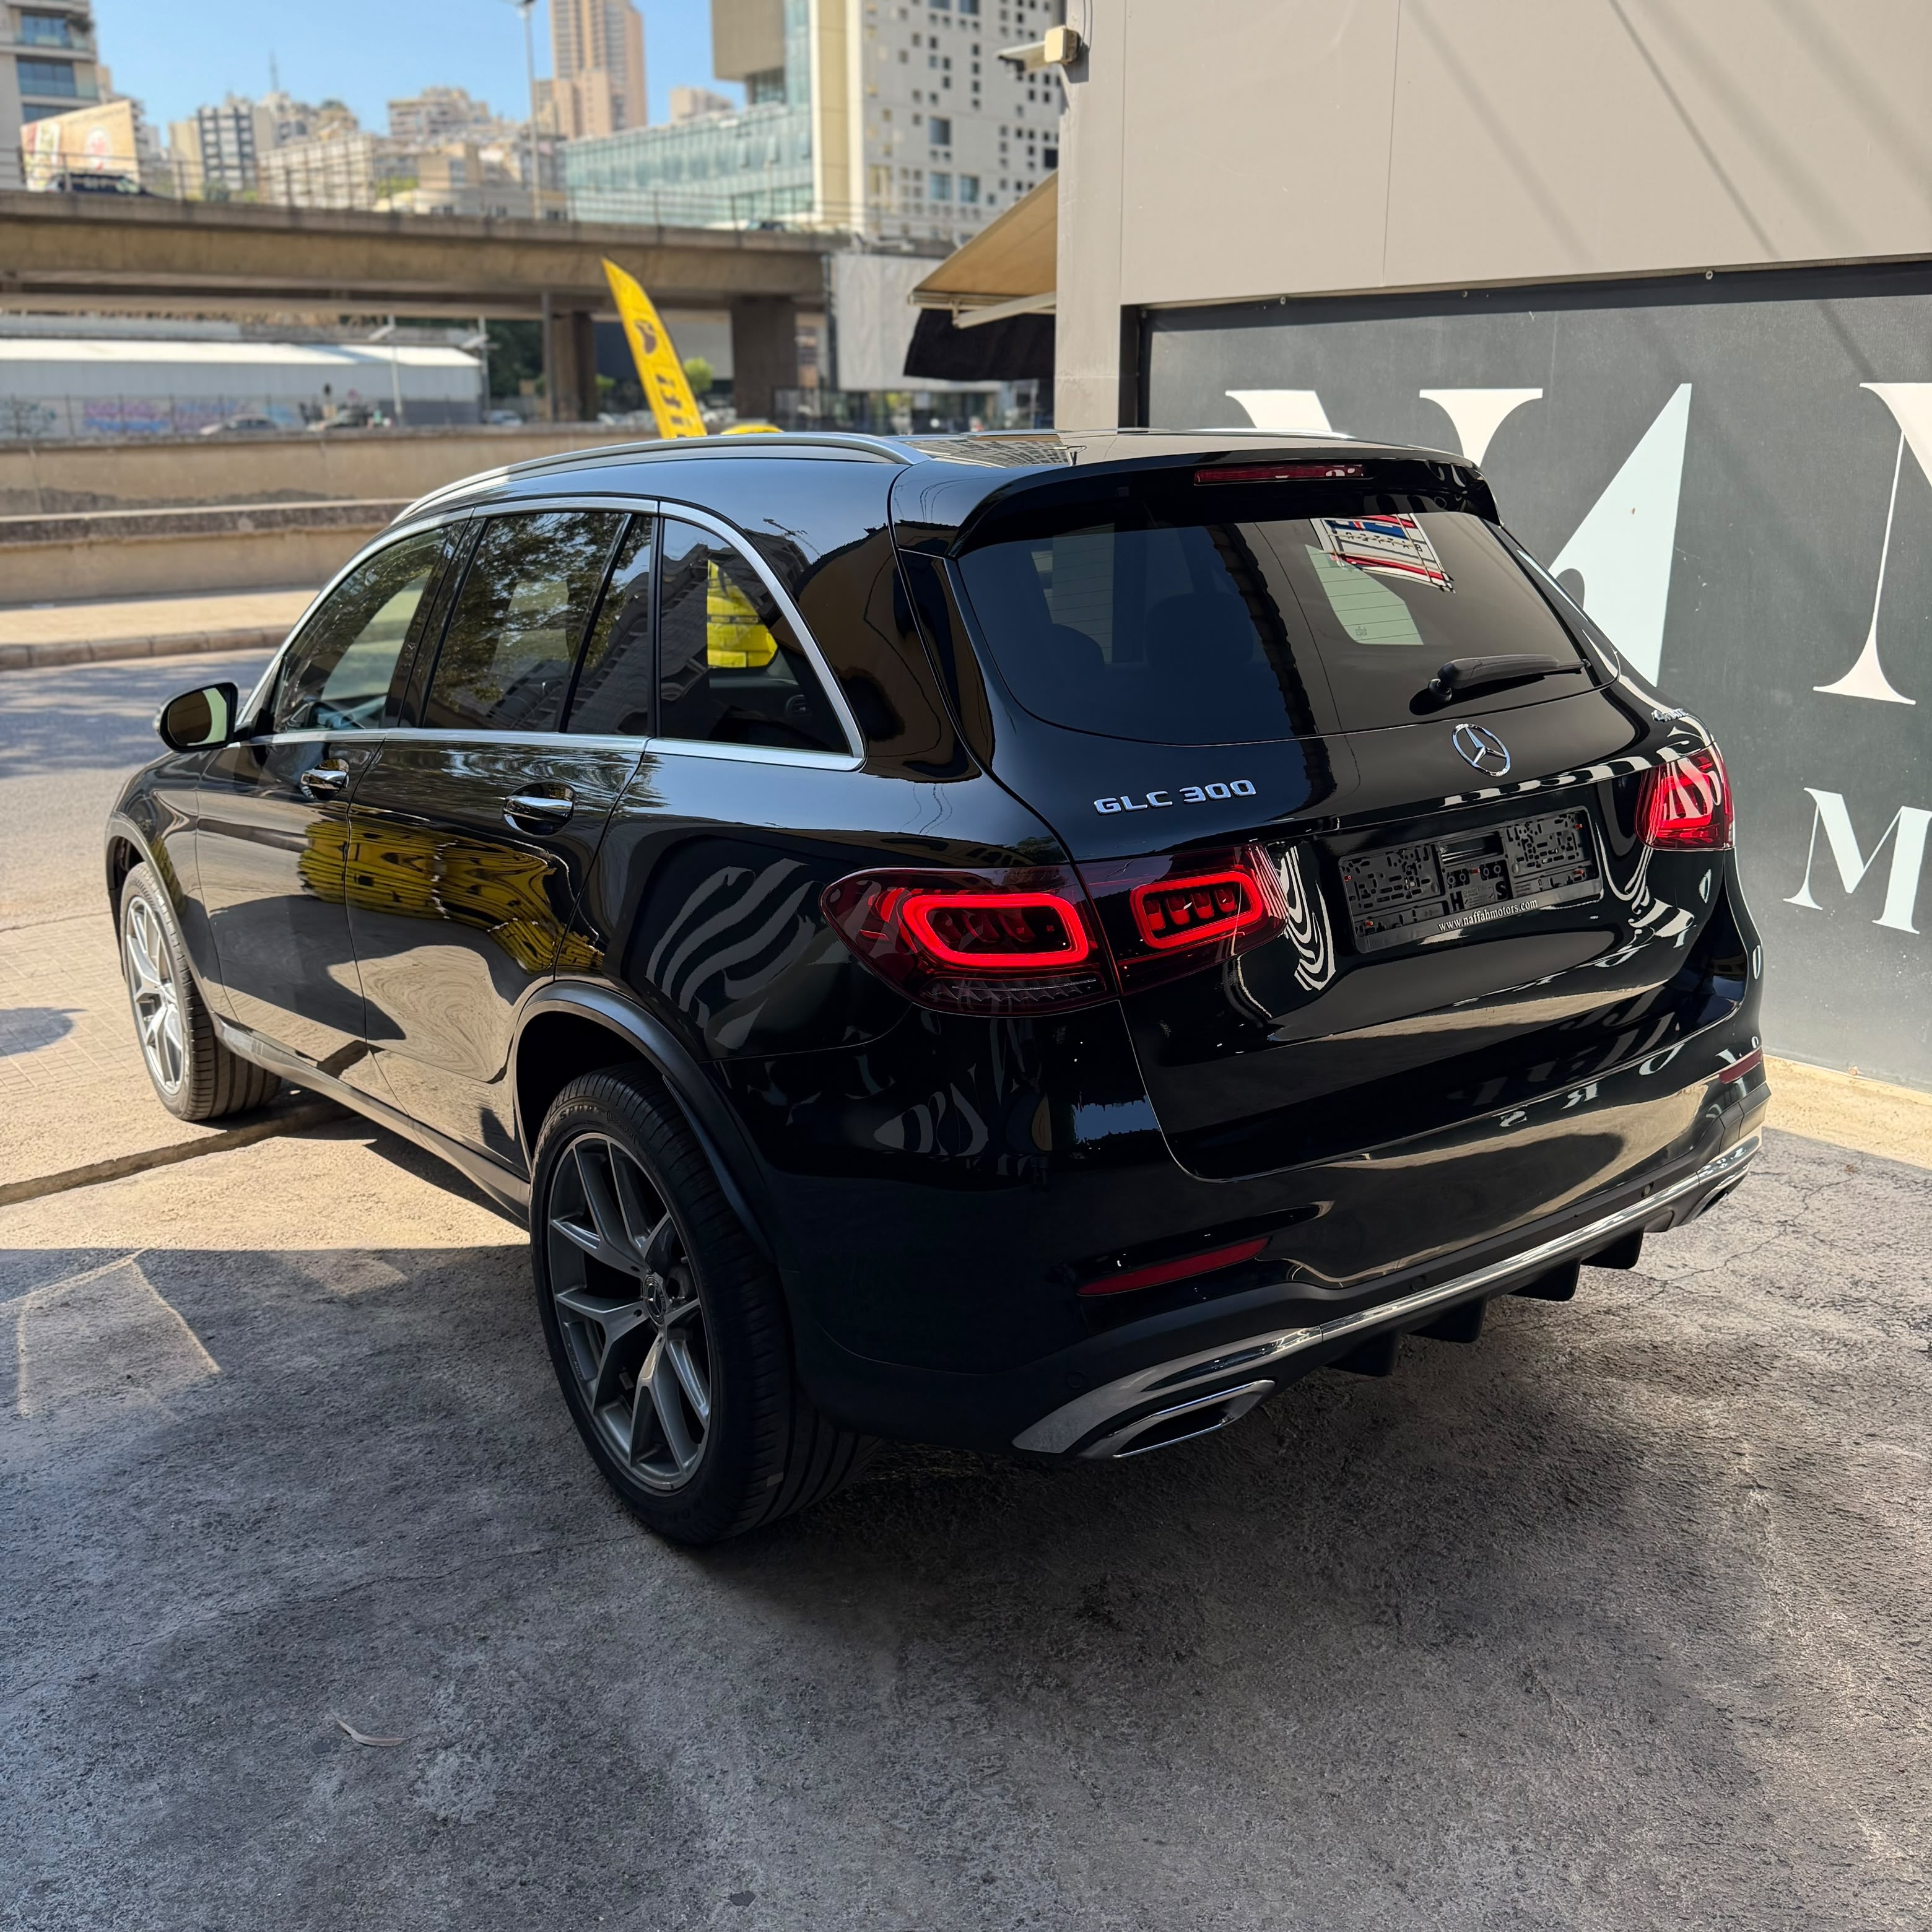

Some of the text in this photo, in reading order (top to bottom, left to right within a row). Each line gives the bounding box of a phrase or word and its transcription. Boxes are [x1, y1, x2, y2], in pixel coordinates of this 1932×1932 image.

[1094, 780, 1257, 815] GLC 300
[1438, 899, 1538, 932] www.naffahmotors.com
